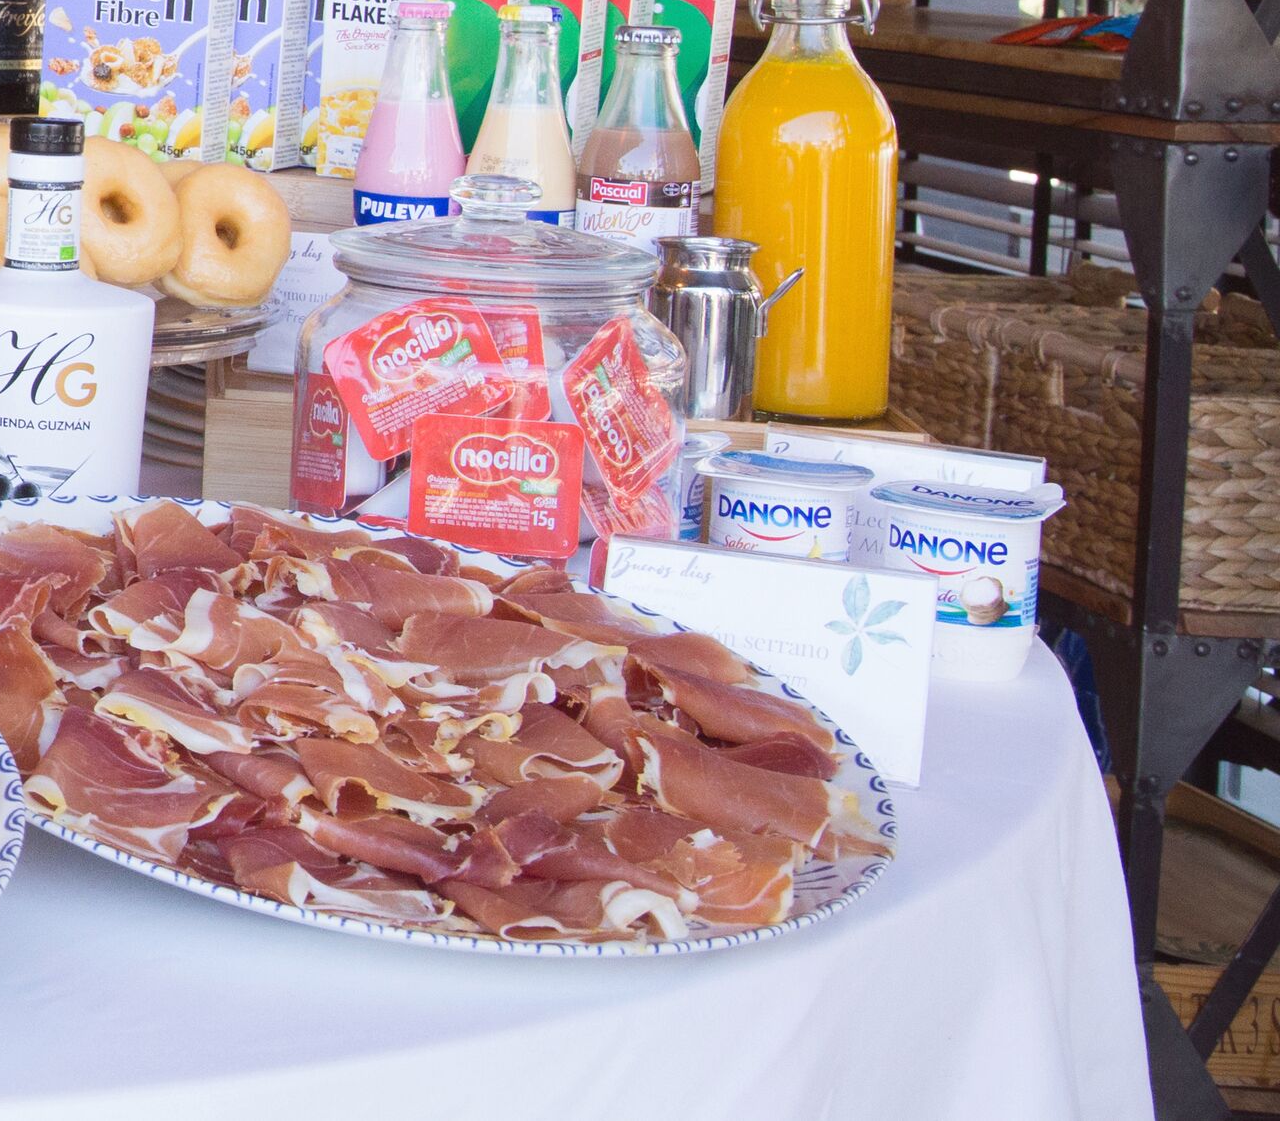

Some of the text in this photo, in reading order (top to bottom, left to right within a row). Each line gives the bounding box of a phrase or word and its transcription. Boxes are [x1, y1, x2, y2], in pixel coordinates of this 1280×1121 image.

[96, 0, 159, 26] Fibre
[593, 181, 642, 200] Pascual
[360, 196, 436, 220] PULEVA
[377, 317, 454, 375] nocilla
[37, 417, 91, 431] GUZMÁN
[460, 446, 548, 473] nocilla
[912, 484, 1035, 508] DANONE
[531, 510, 556, 531] 15g
[718, 493, 833, 529] DANONE
[724, 534, 759, 552] Sabor
[889, 524, 1009, 566] DANONE
[610, 546, 672, 579] Buenos
[743, 634, 830, 663] serrano
